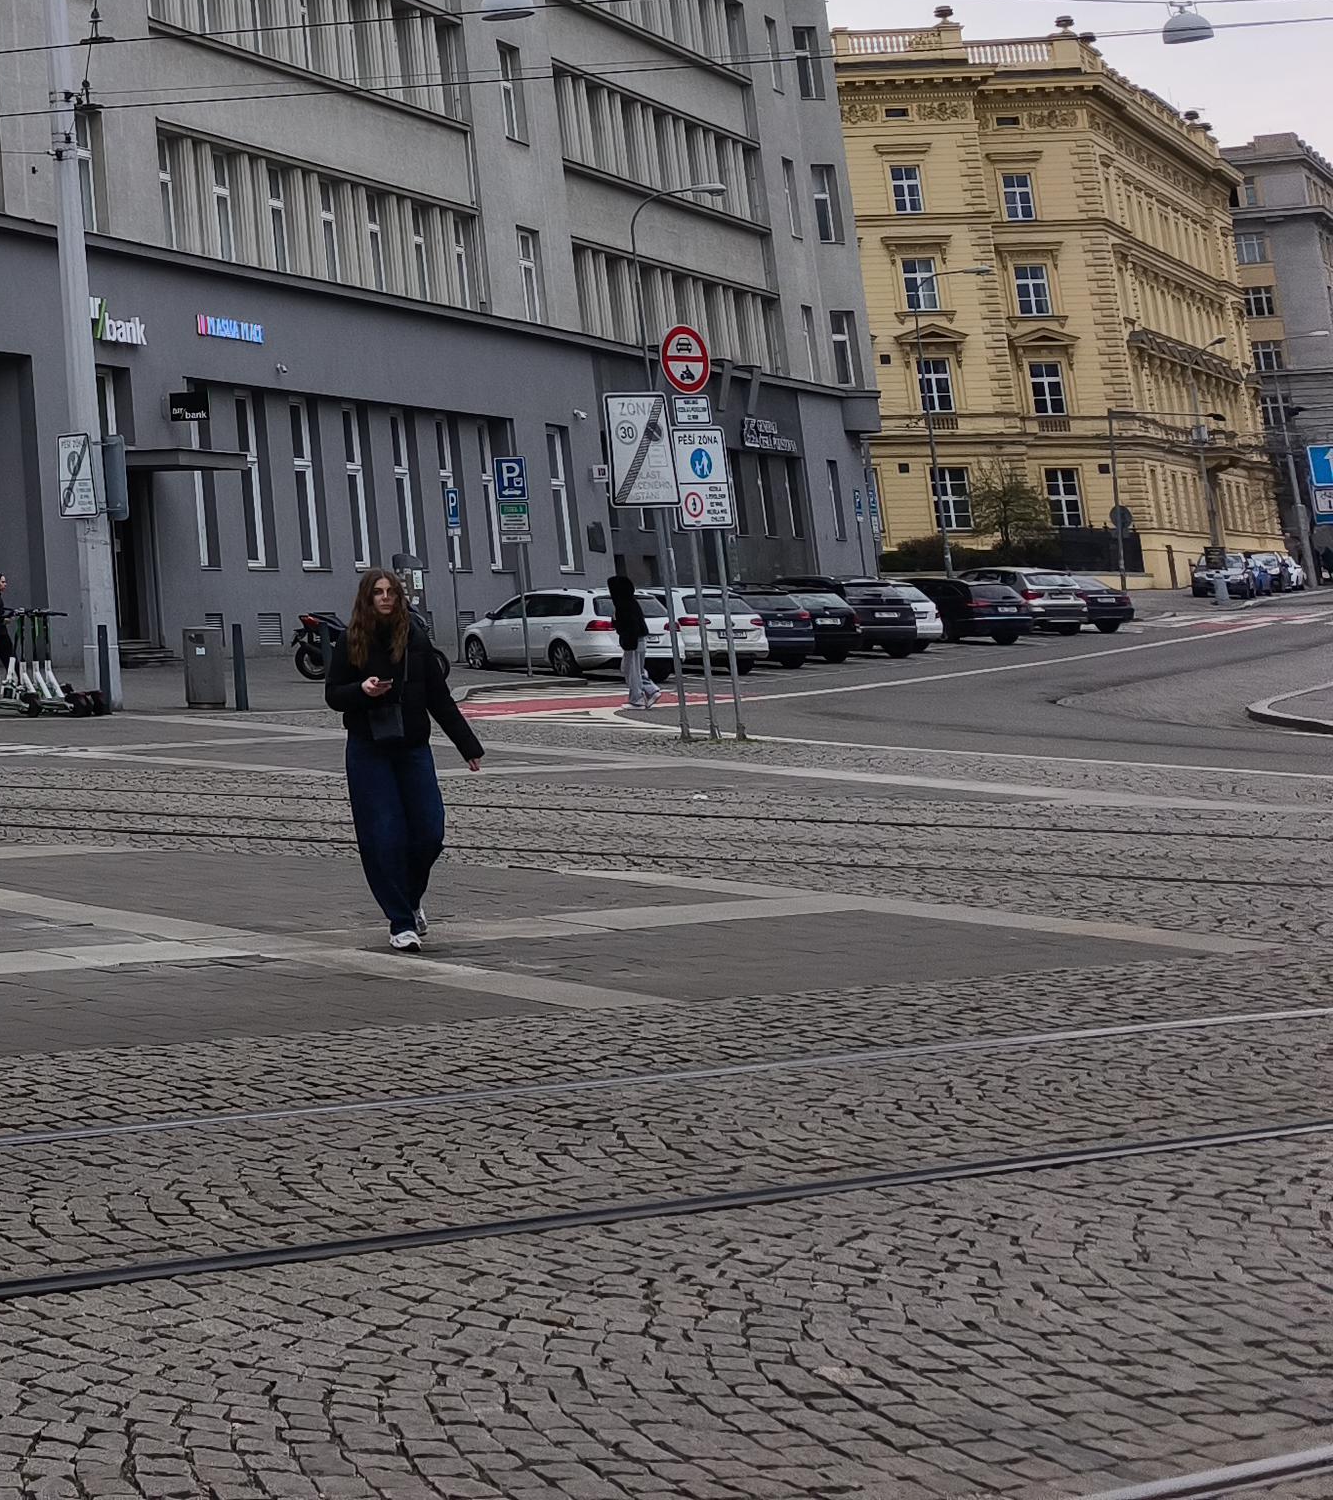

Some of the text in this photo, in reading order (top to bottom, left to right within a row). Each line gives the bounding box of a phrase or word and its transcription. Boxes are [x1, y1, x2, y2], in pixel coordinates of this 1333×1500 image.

[89, 297, 147, 345] ir/bank
[619, 426, 634, 439] 30
[698, 433, 719, 445] ZÓNA
[501, 462, 520, 487] P
[448, 492, 457, 515] P
